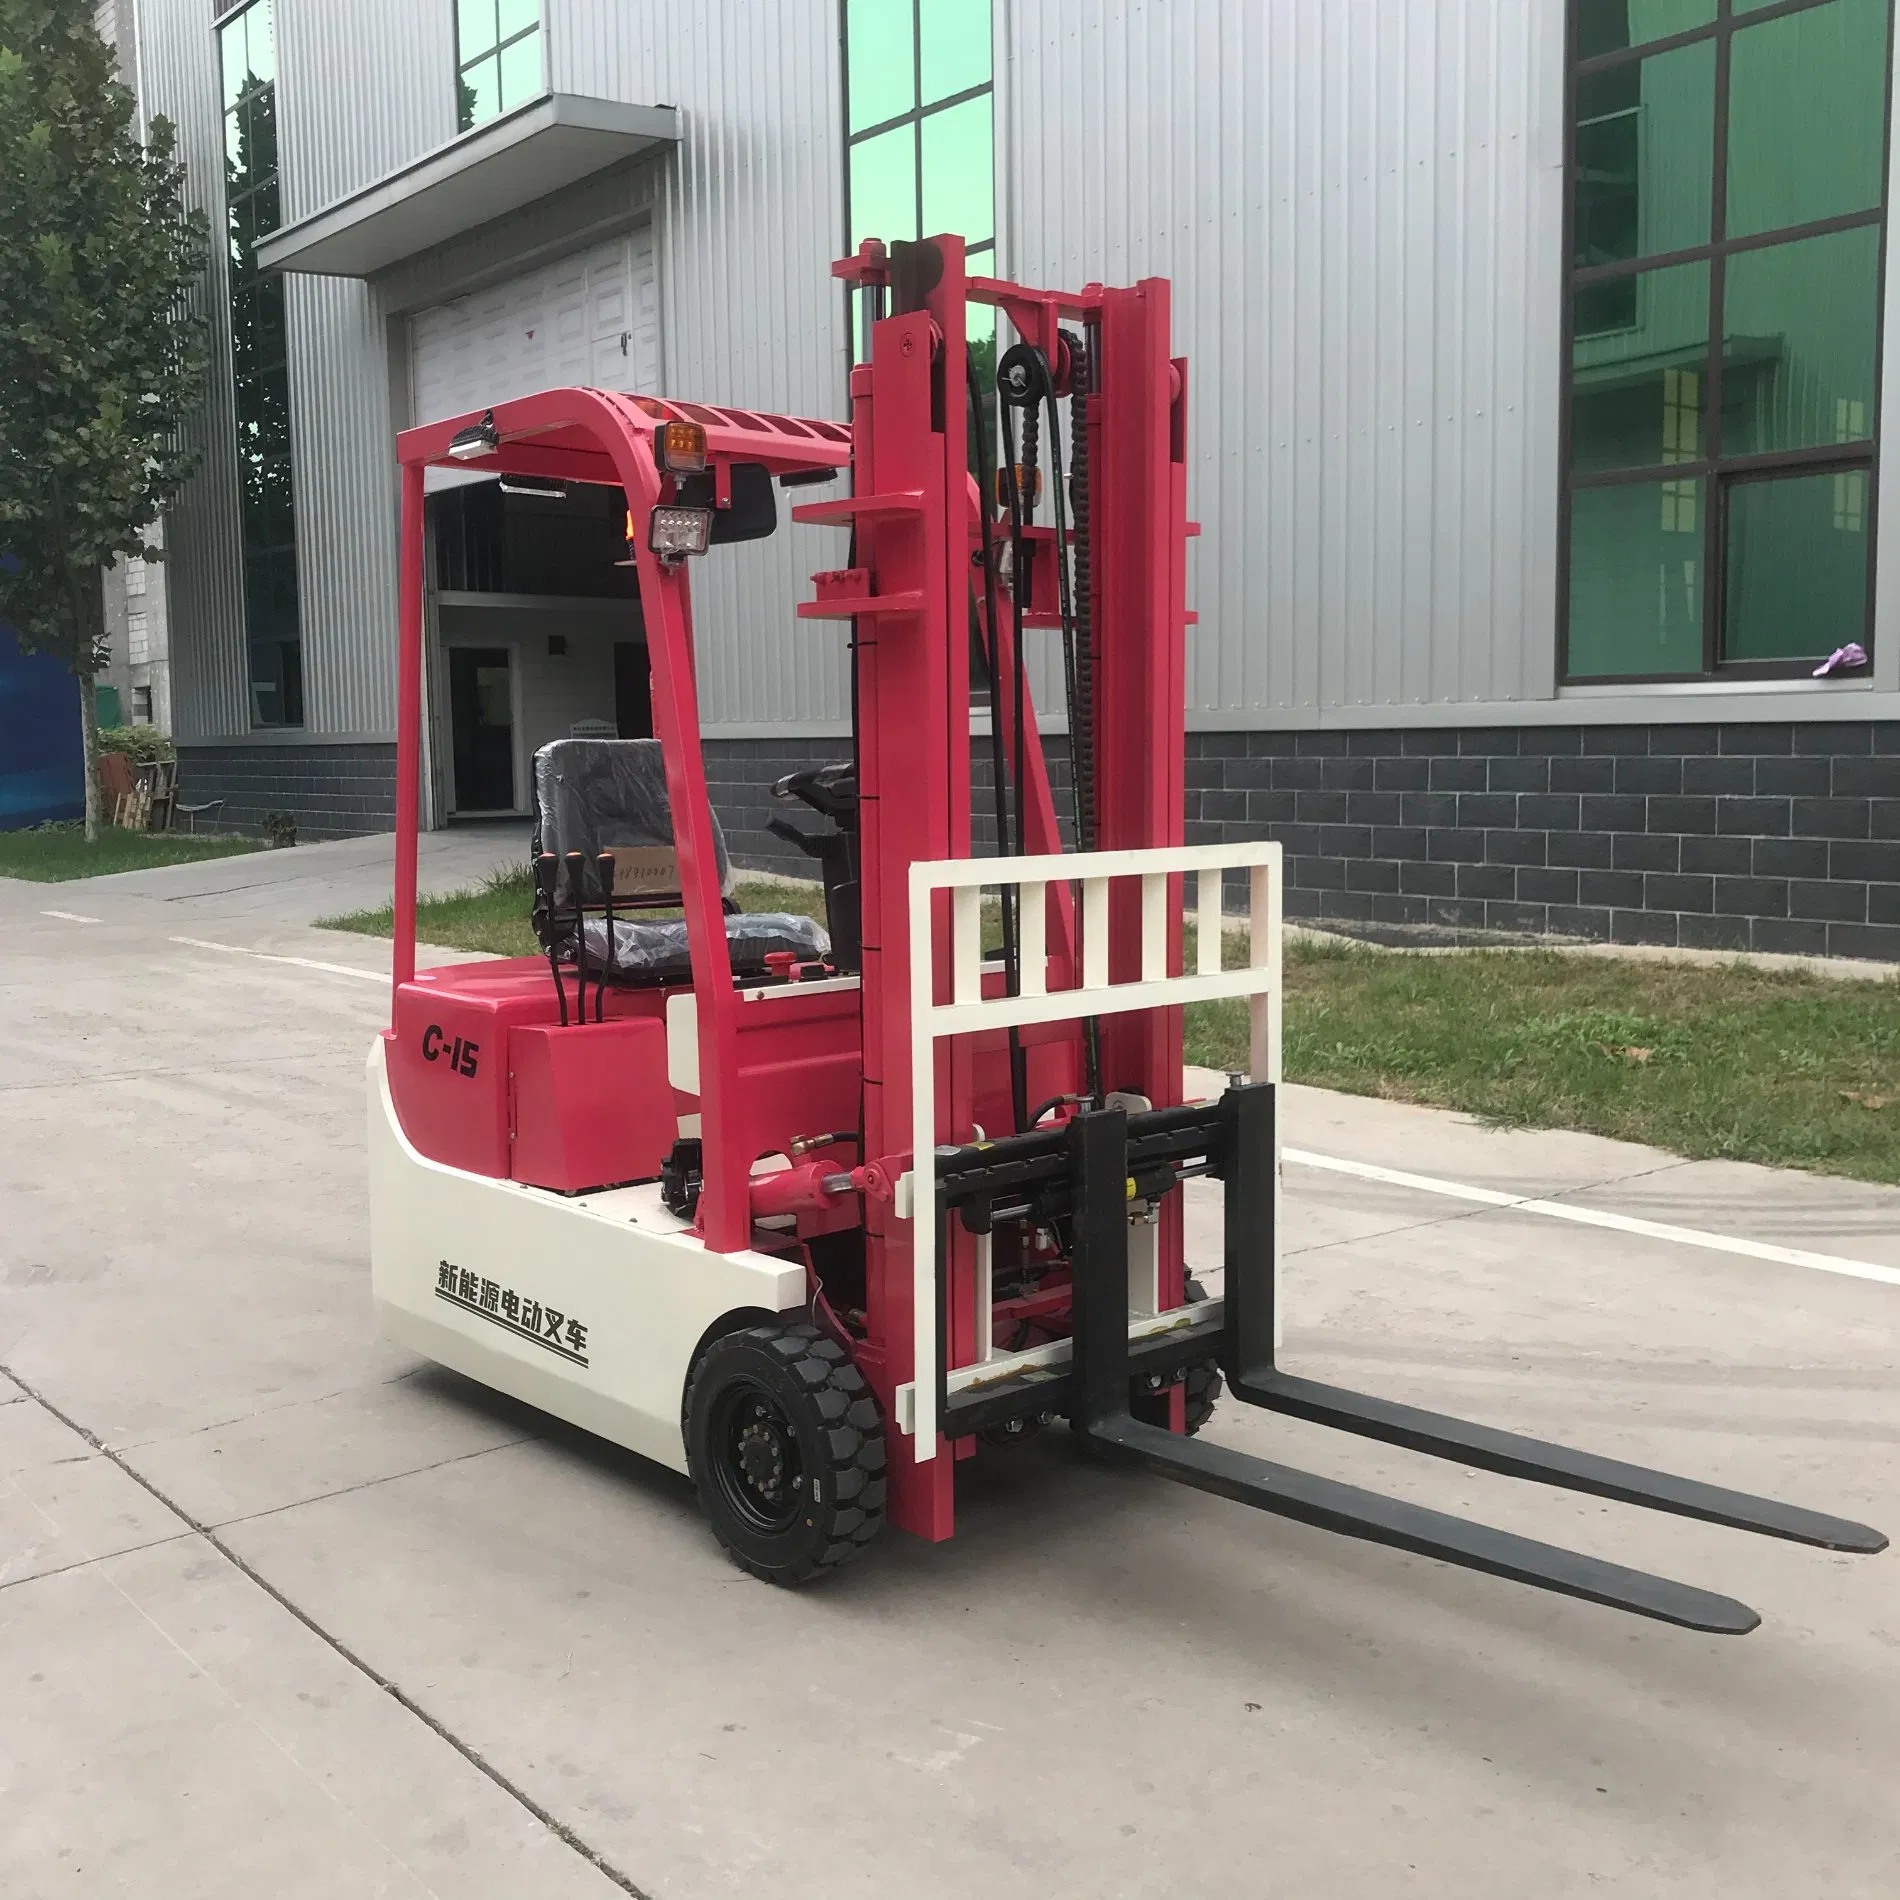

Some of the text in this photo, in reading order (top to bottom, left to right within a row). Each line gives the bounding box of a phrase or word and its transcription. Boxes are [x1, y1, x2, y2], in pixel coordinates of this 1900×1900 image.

[422, 1024, 480, 1079] C-15
[437, 1259, 589, 1352] 新能源电动叉车
